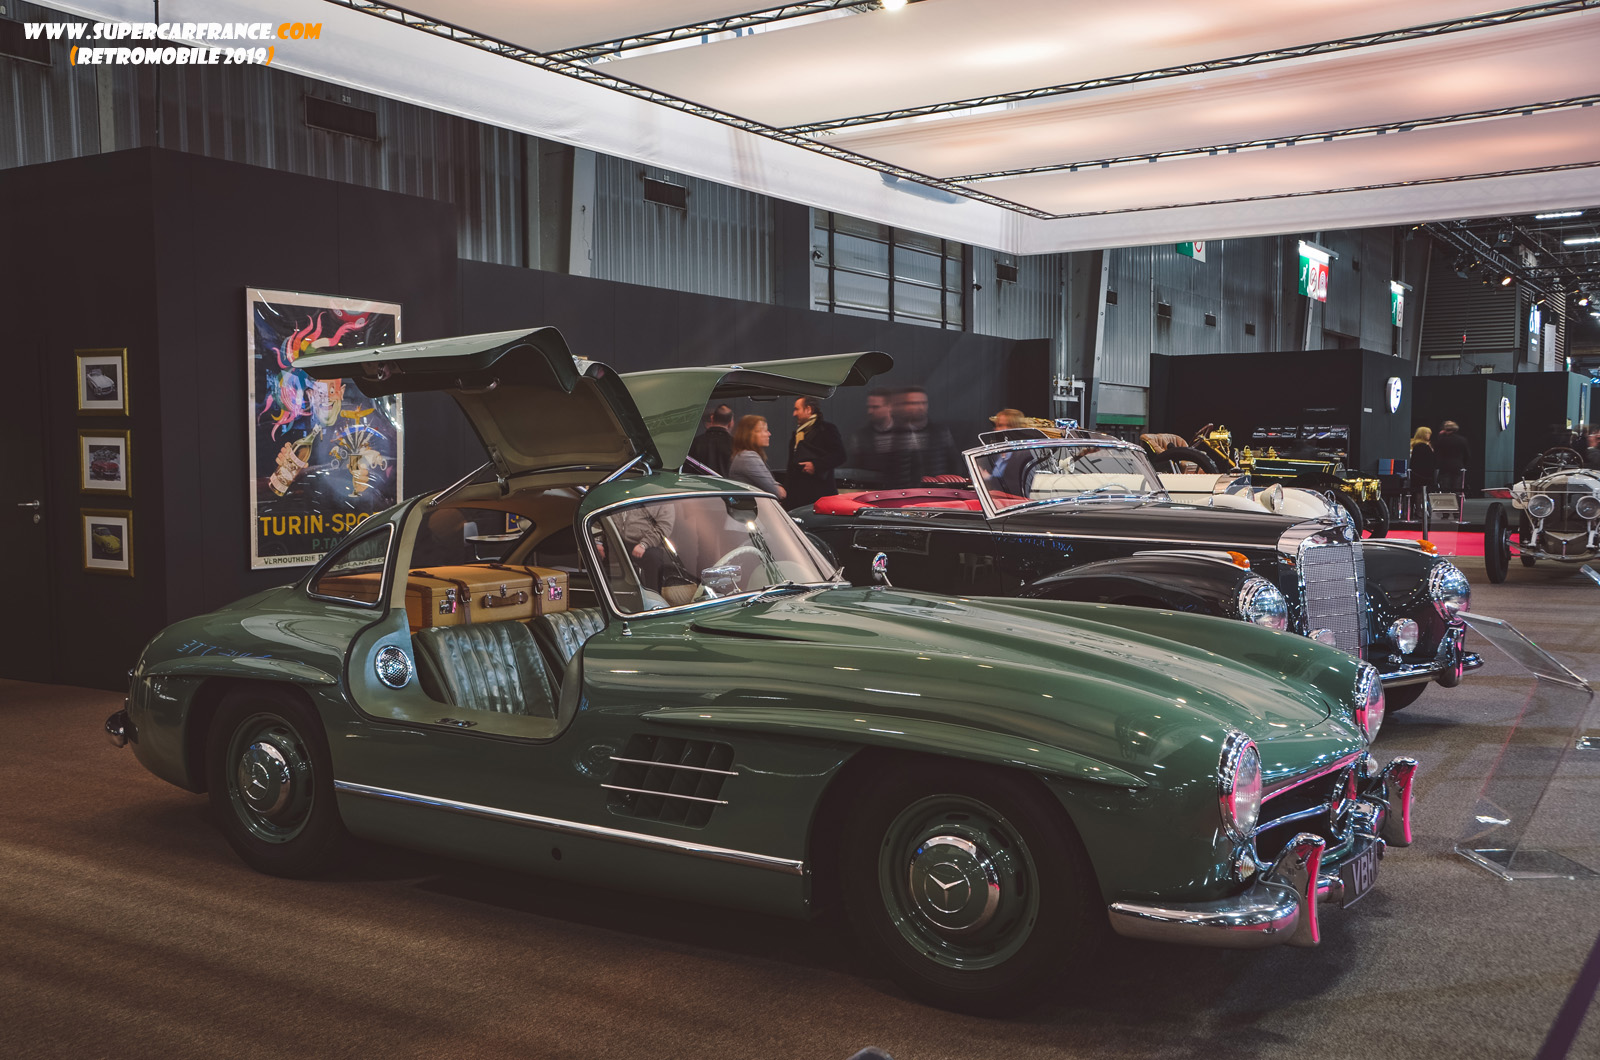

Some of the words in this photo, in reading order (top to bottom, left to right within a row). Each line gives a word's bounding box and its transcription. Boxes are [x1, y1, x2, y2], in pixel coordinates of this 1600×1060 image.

[260, 511, 380, 537] TURIN-SPO
[312, 537, 343, 551] P.TA
[263, 555, 316, 565] VERMOUTHERIE
